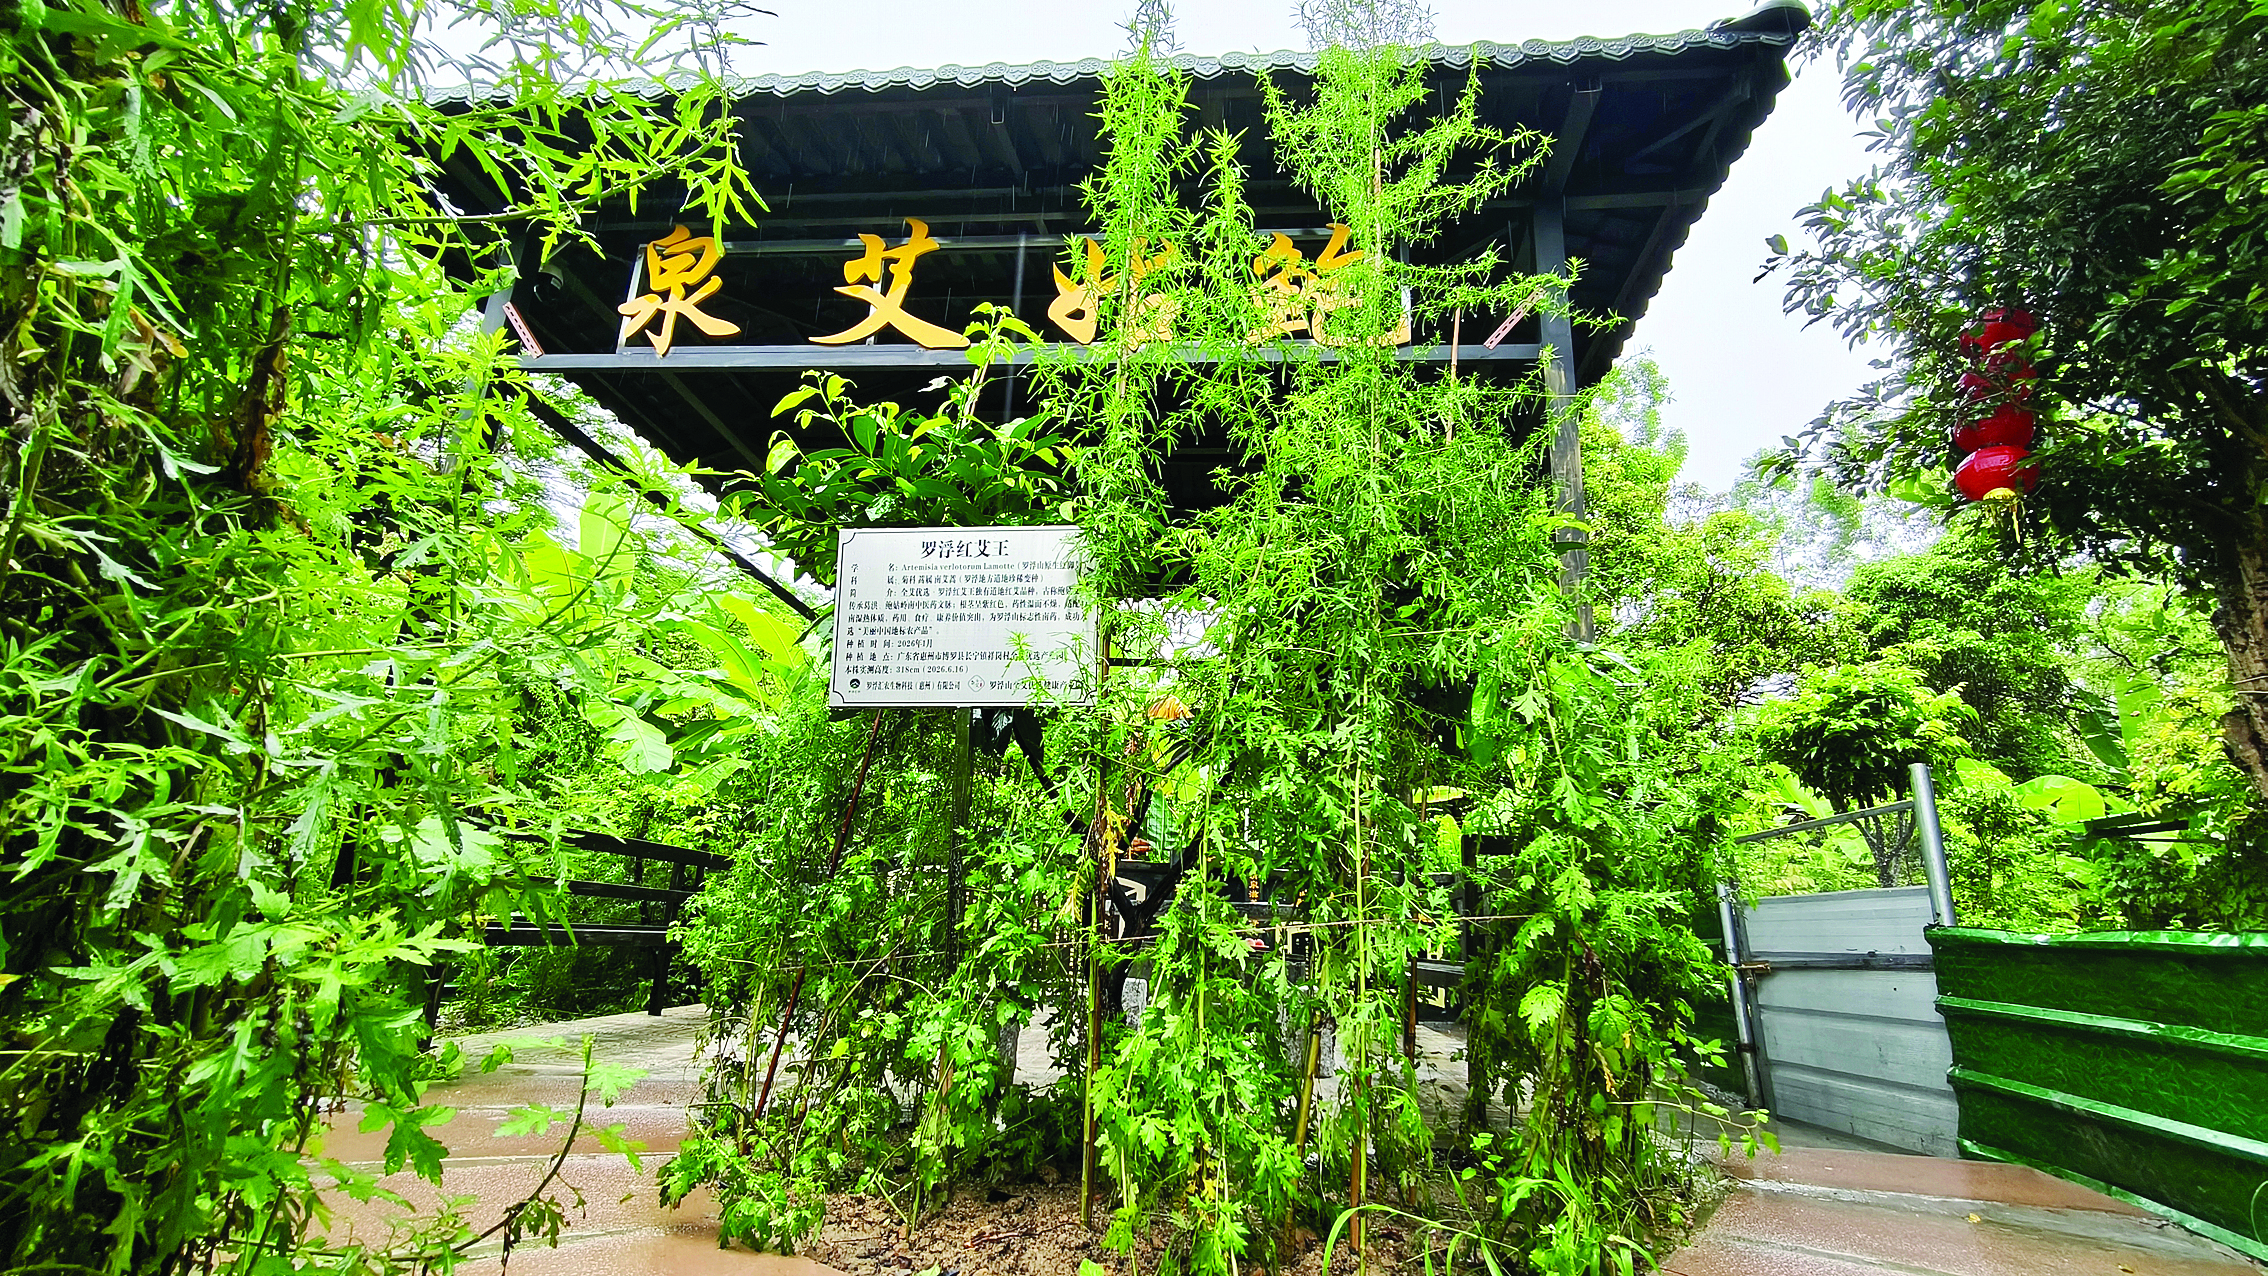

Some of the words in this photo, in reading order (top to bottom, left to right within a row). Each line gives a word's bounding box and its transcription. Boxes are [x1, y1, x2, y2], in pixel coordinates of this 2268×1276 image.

[921, 539, 1009, 559] 罗浮红艾王
[901, 563, 938, 572] Artemisia
[939, 563, 982, 571] verlotorum
[983, 562, 1015, 570] Lamotte
